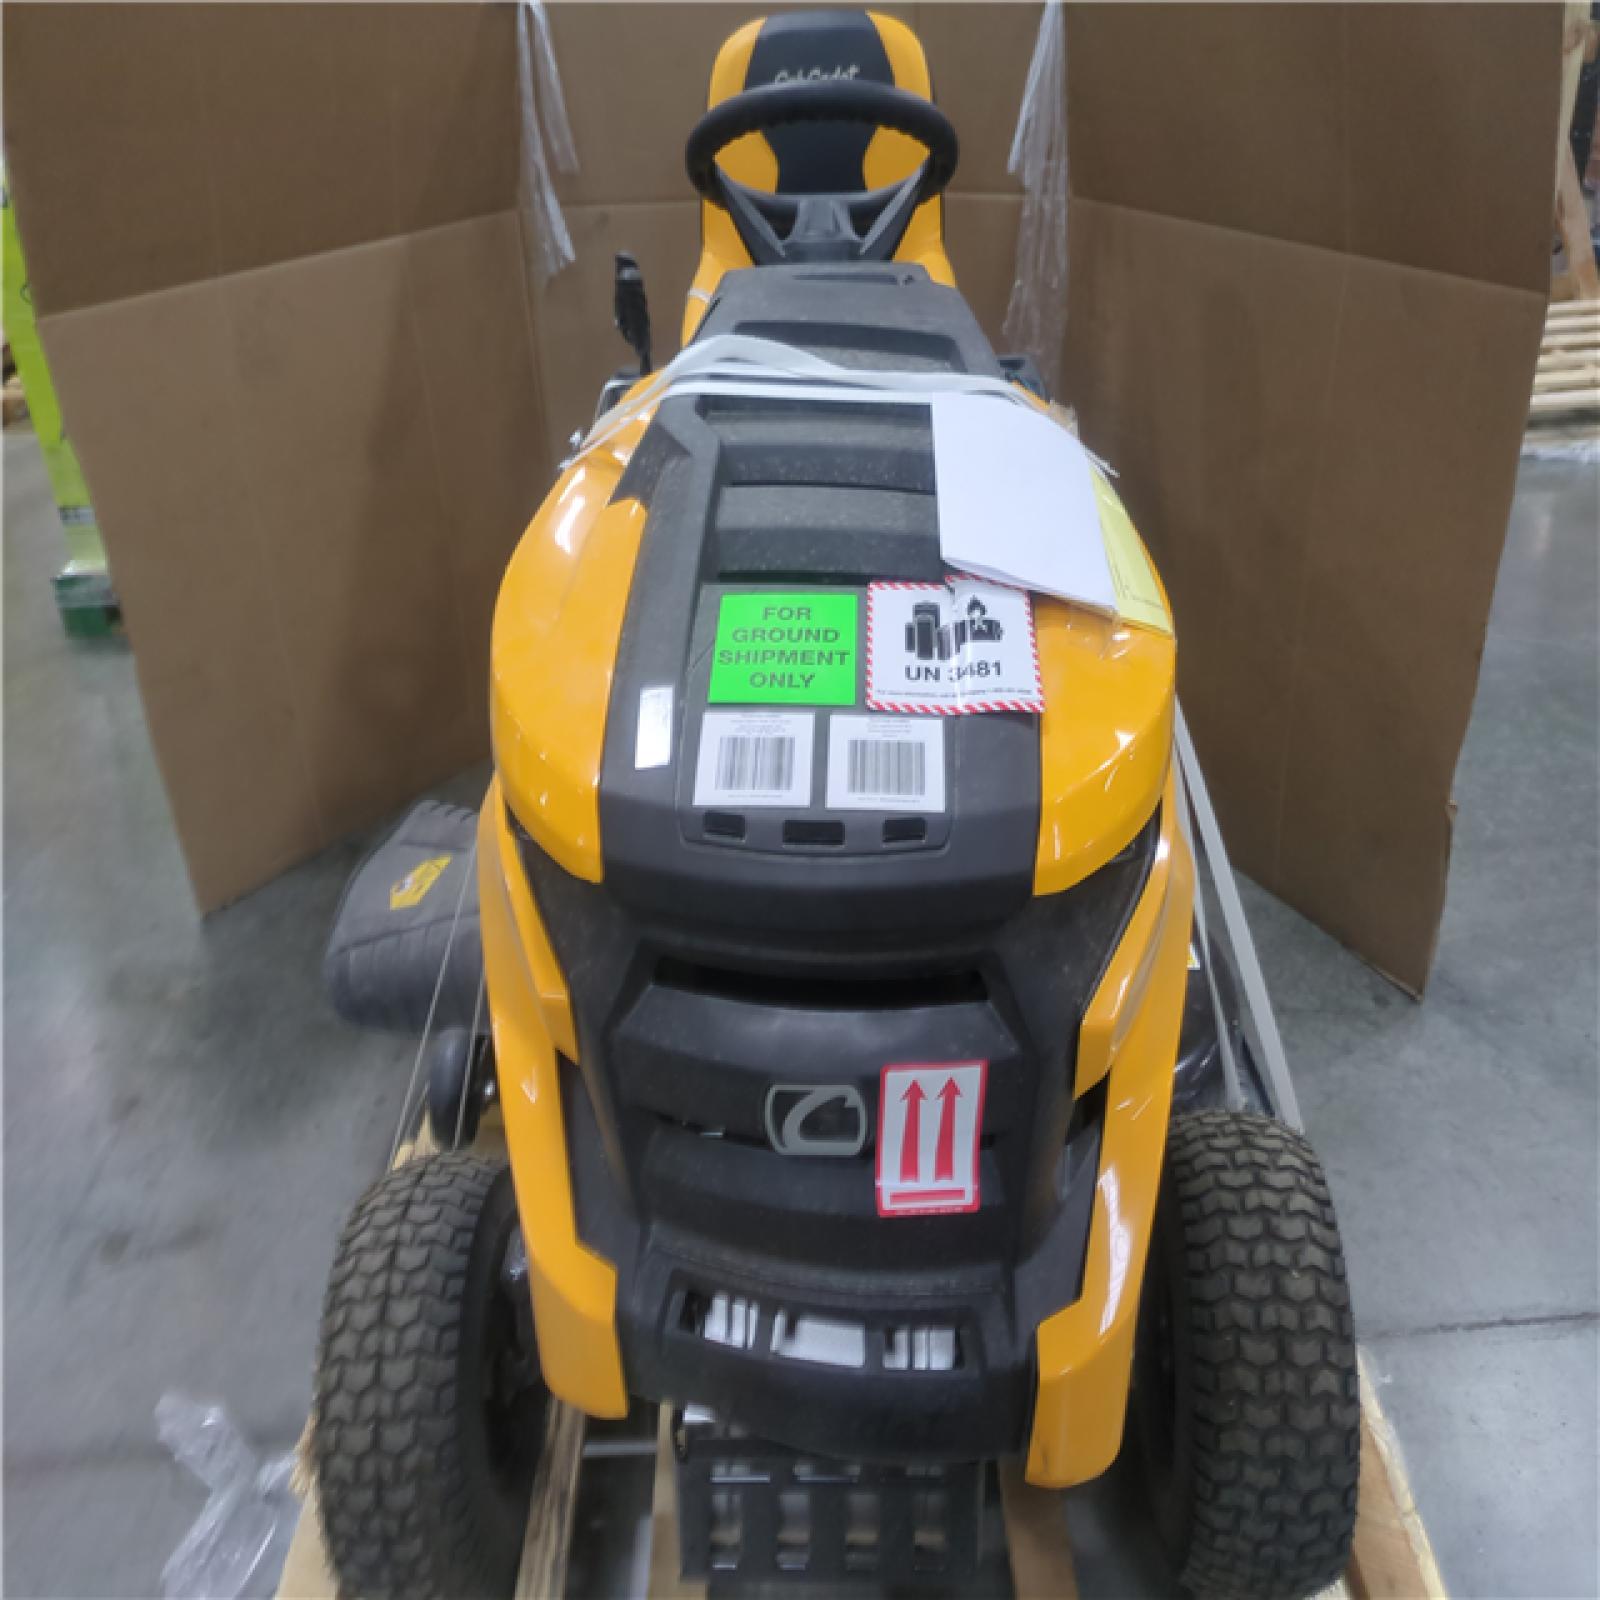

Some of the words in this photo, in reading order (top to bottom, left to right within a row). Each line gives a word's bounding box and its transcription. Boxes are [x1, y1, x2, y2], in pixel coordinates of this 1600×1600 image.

[763, 606, 811, 621] FOR
[732, 627, 841, 644] GROUND
[718, 649, 851, 667] SHIPMENT
[748, 671, 816, 689] ONLY
[904, 664, 941, 682] UN
